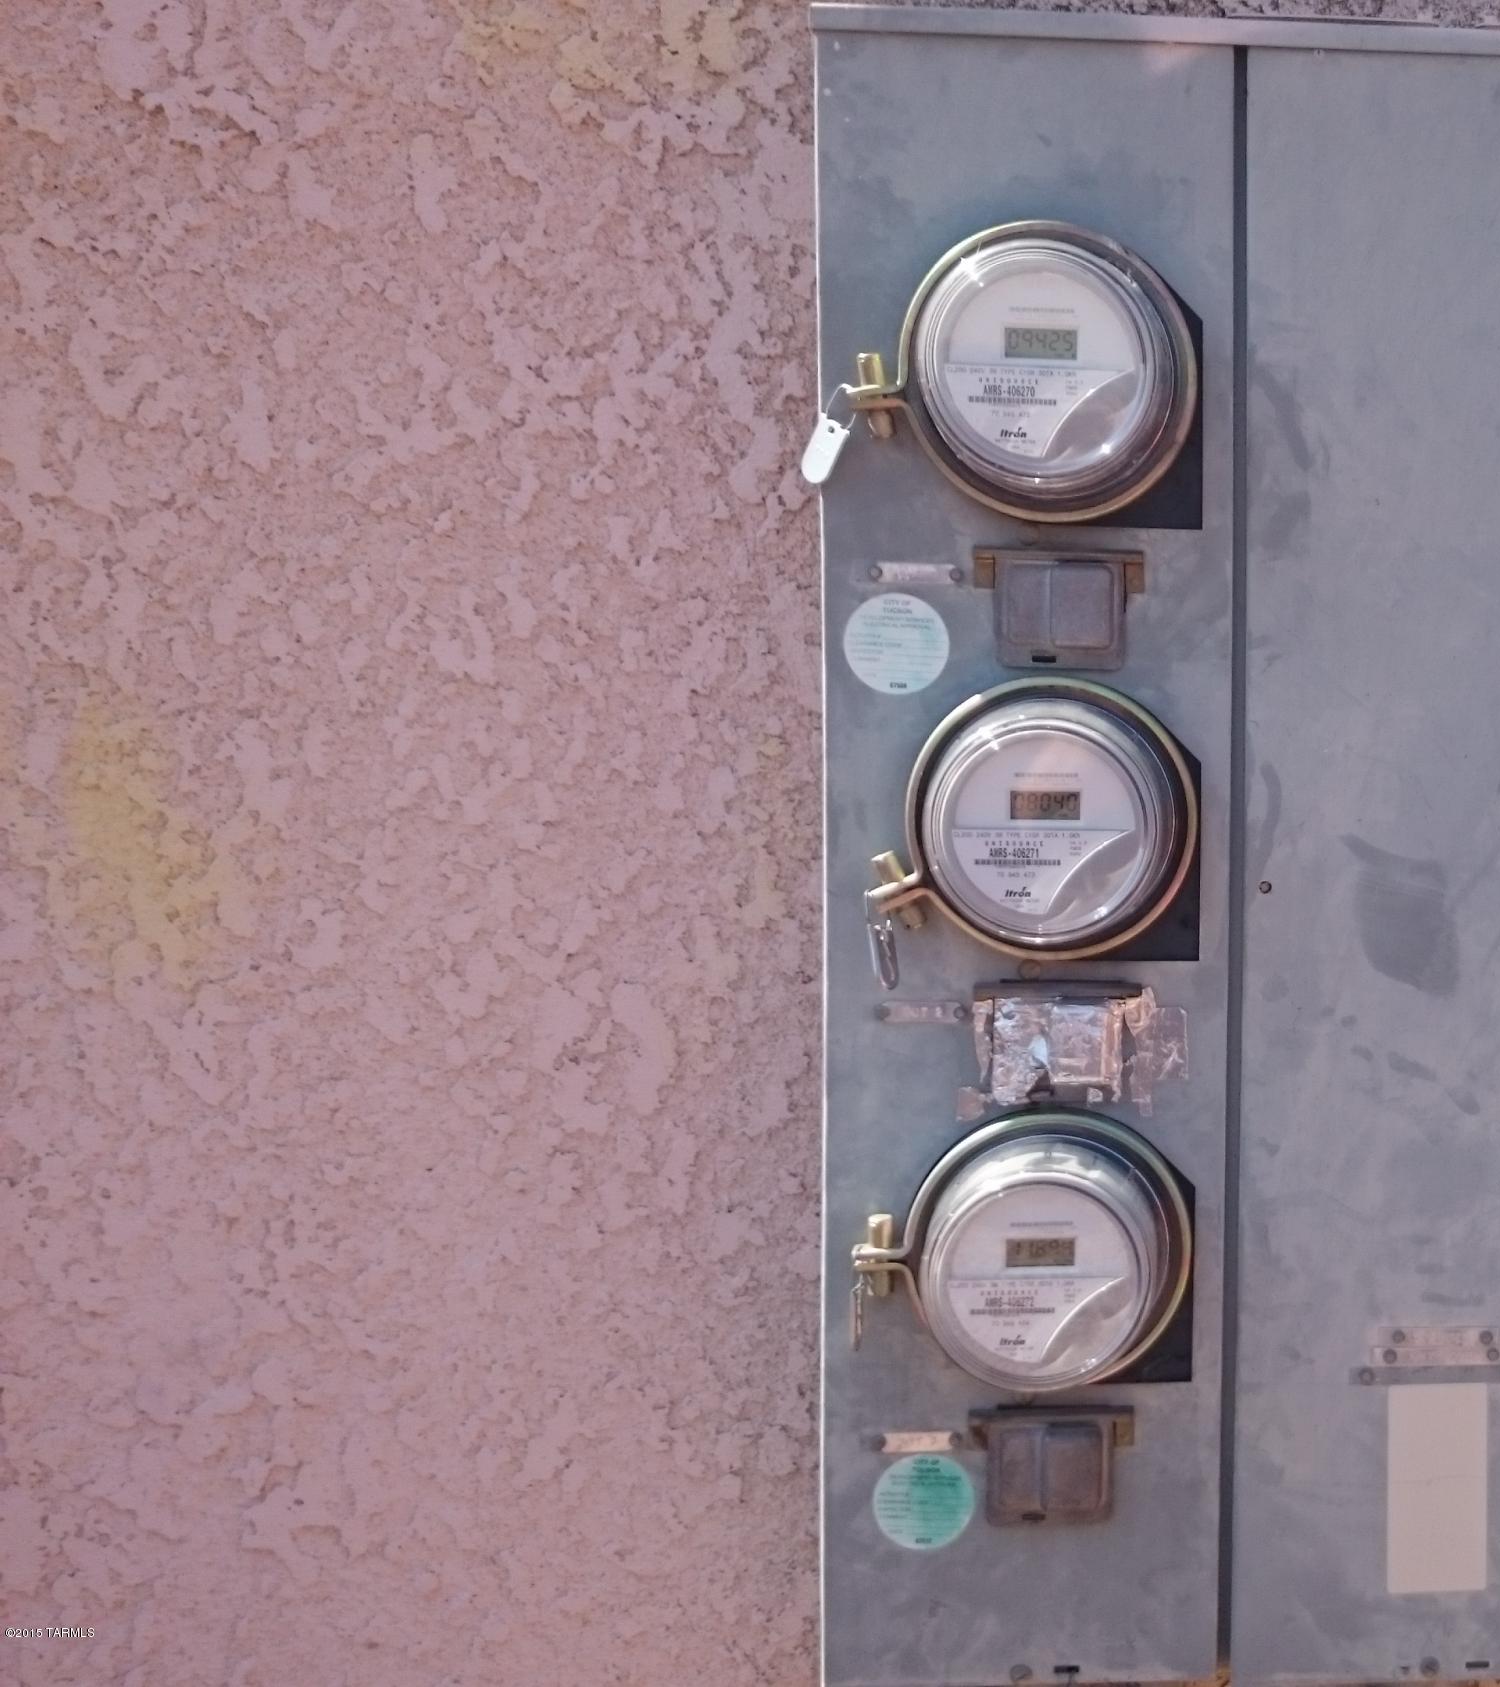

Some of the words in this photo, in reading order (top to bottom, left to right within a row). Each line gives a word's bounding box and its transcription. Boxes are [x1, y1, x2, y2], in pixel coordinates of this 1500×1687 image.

[1006, 330, 1075, 352] 09425
[983, 385, 1036, 397] AMRS-406270
[999, 427, 1027, 438] Itron
[1004, 886, 1032, 897] Itron
